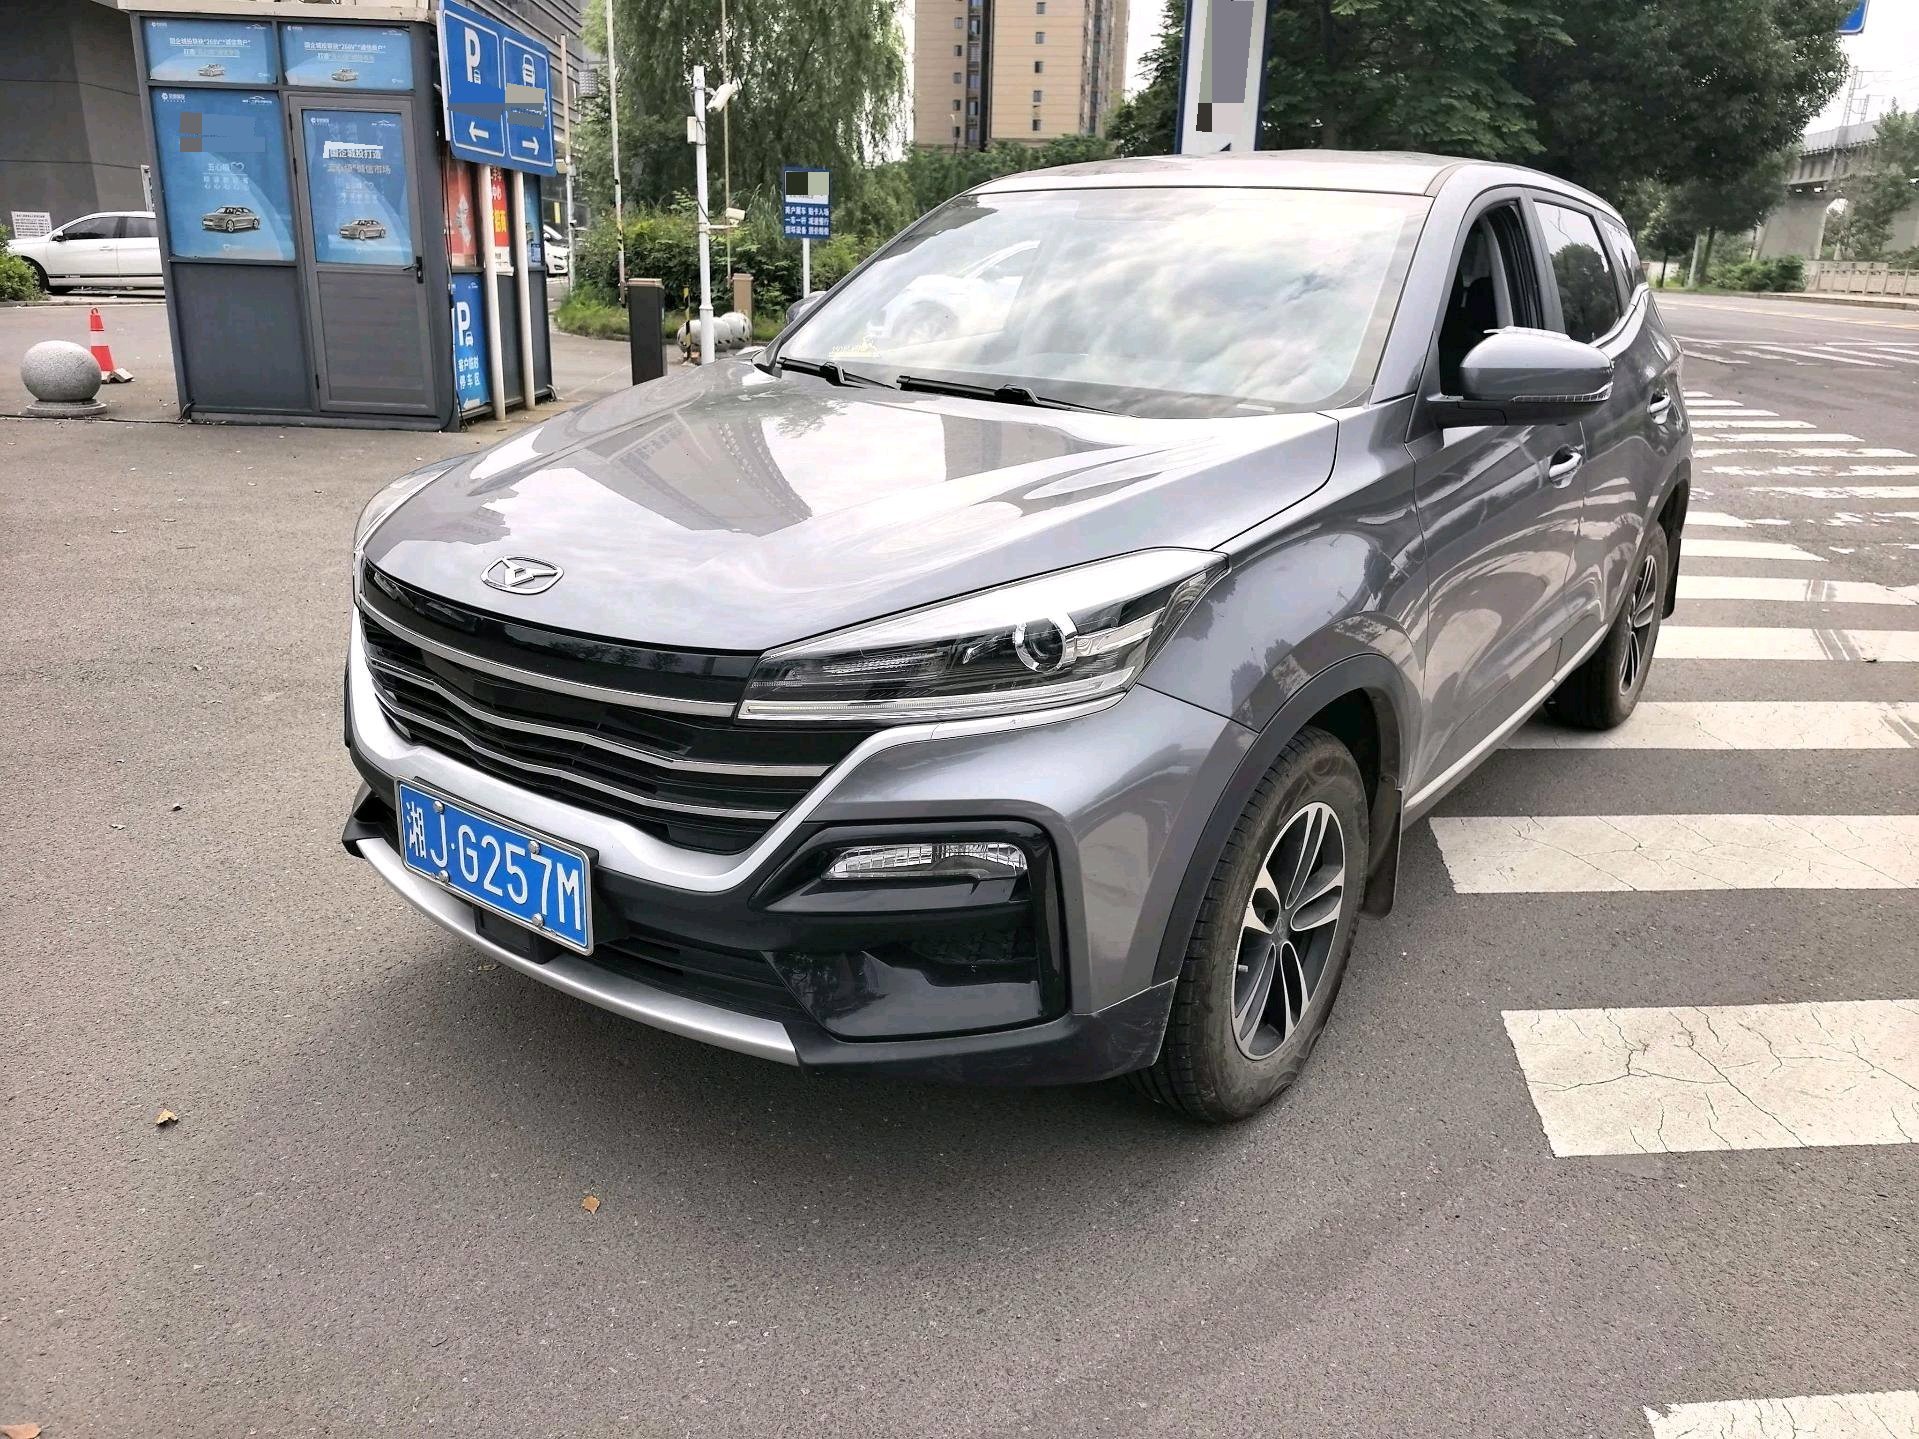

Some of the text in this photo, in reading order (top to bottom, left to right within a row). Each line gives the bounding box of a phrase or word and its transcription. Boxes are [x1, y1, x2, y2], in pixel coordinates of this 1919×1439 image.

[464, 26, 481, 83] P
[456, 301, 472, 346] P
[459, 372, 481, 390] 停车区
